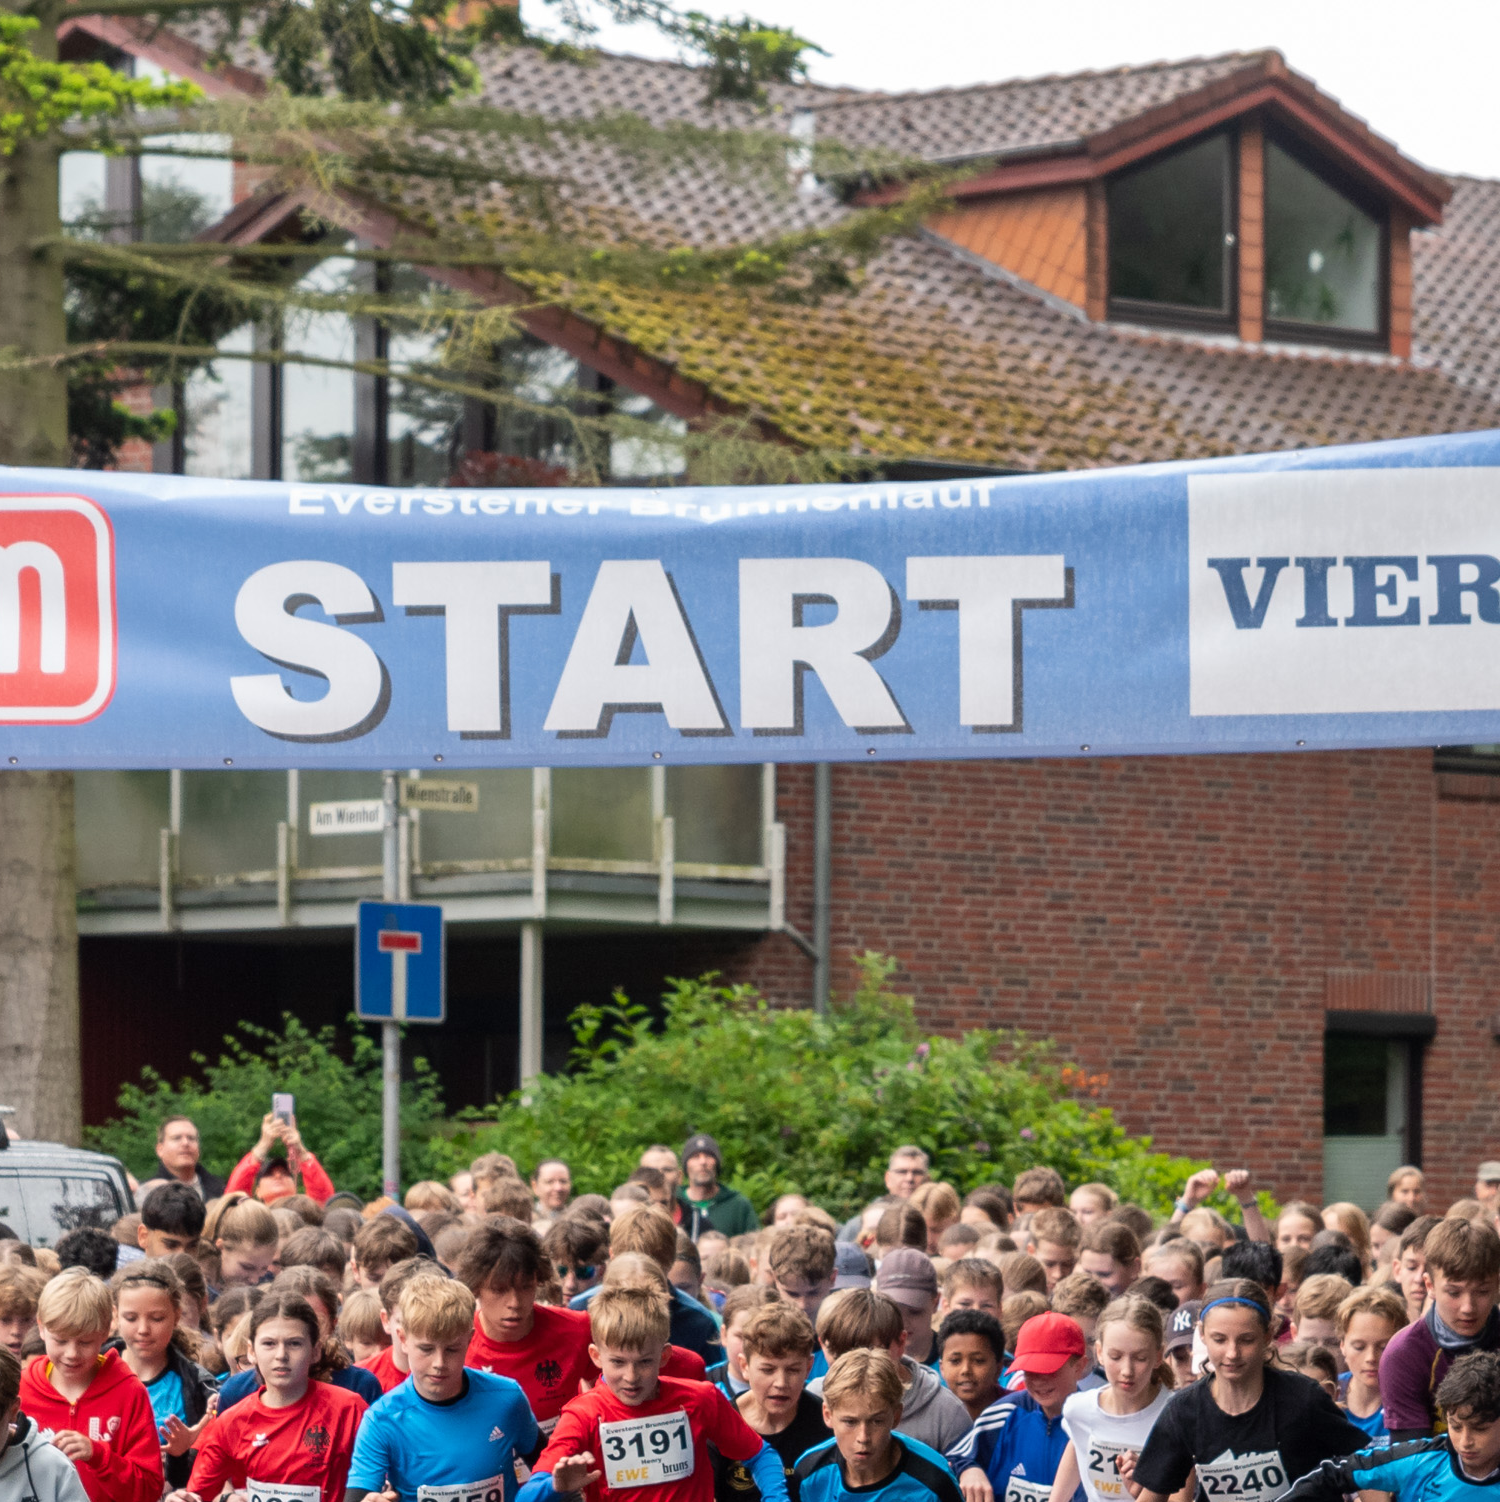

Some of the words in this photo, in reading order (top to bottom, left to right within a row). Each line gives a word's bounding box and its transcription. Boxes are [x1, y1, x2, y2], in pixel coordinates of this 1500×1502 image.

[230, 554, 1074, 743] START
[405, 783, 473, 805] Wienstraße
[315, 808, 334, 827] Am
[336, 804, 380, 825] Wienhof
[605, 1424, 644, 1435] Everstener
[645, 1416, 685, 1429] Brunnenlauf
[604, 1425, 688, 1462] 3191
[640, 1457, 663, 1466] Henry
[661, 1460, 689, 1474] bruns
[1088, 1449, 1120, 1475] 21
[615, 1466, 649, 1482] EWE
[1202, 1465, 1284, 1495] 2240
[1094, 1480, 1122, 1494] EWE
